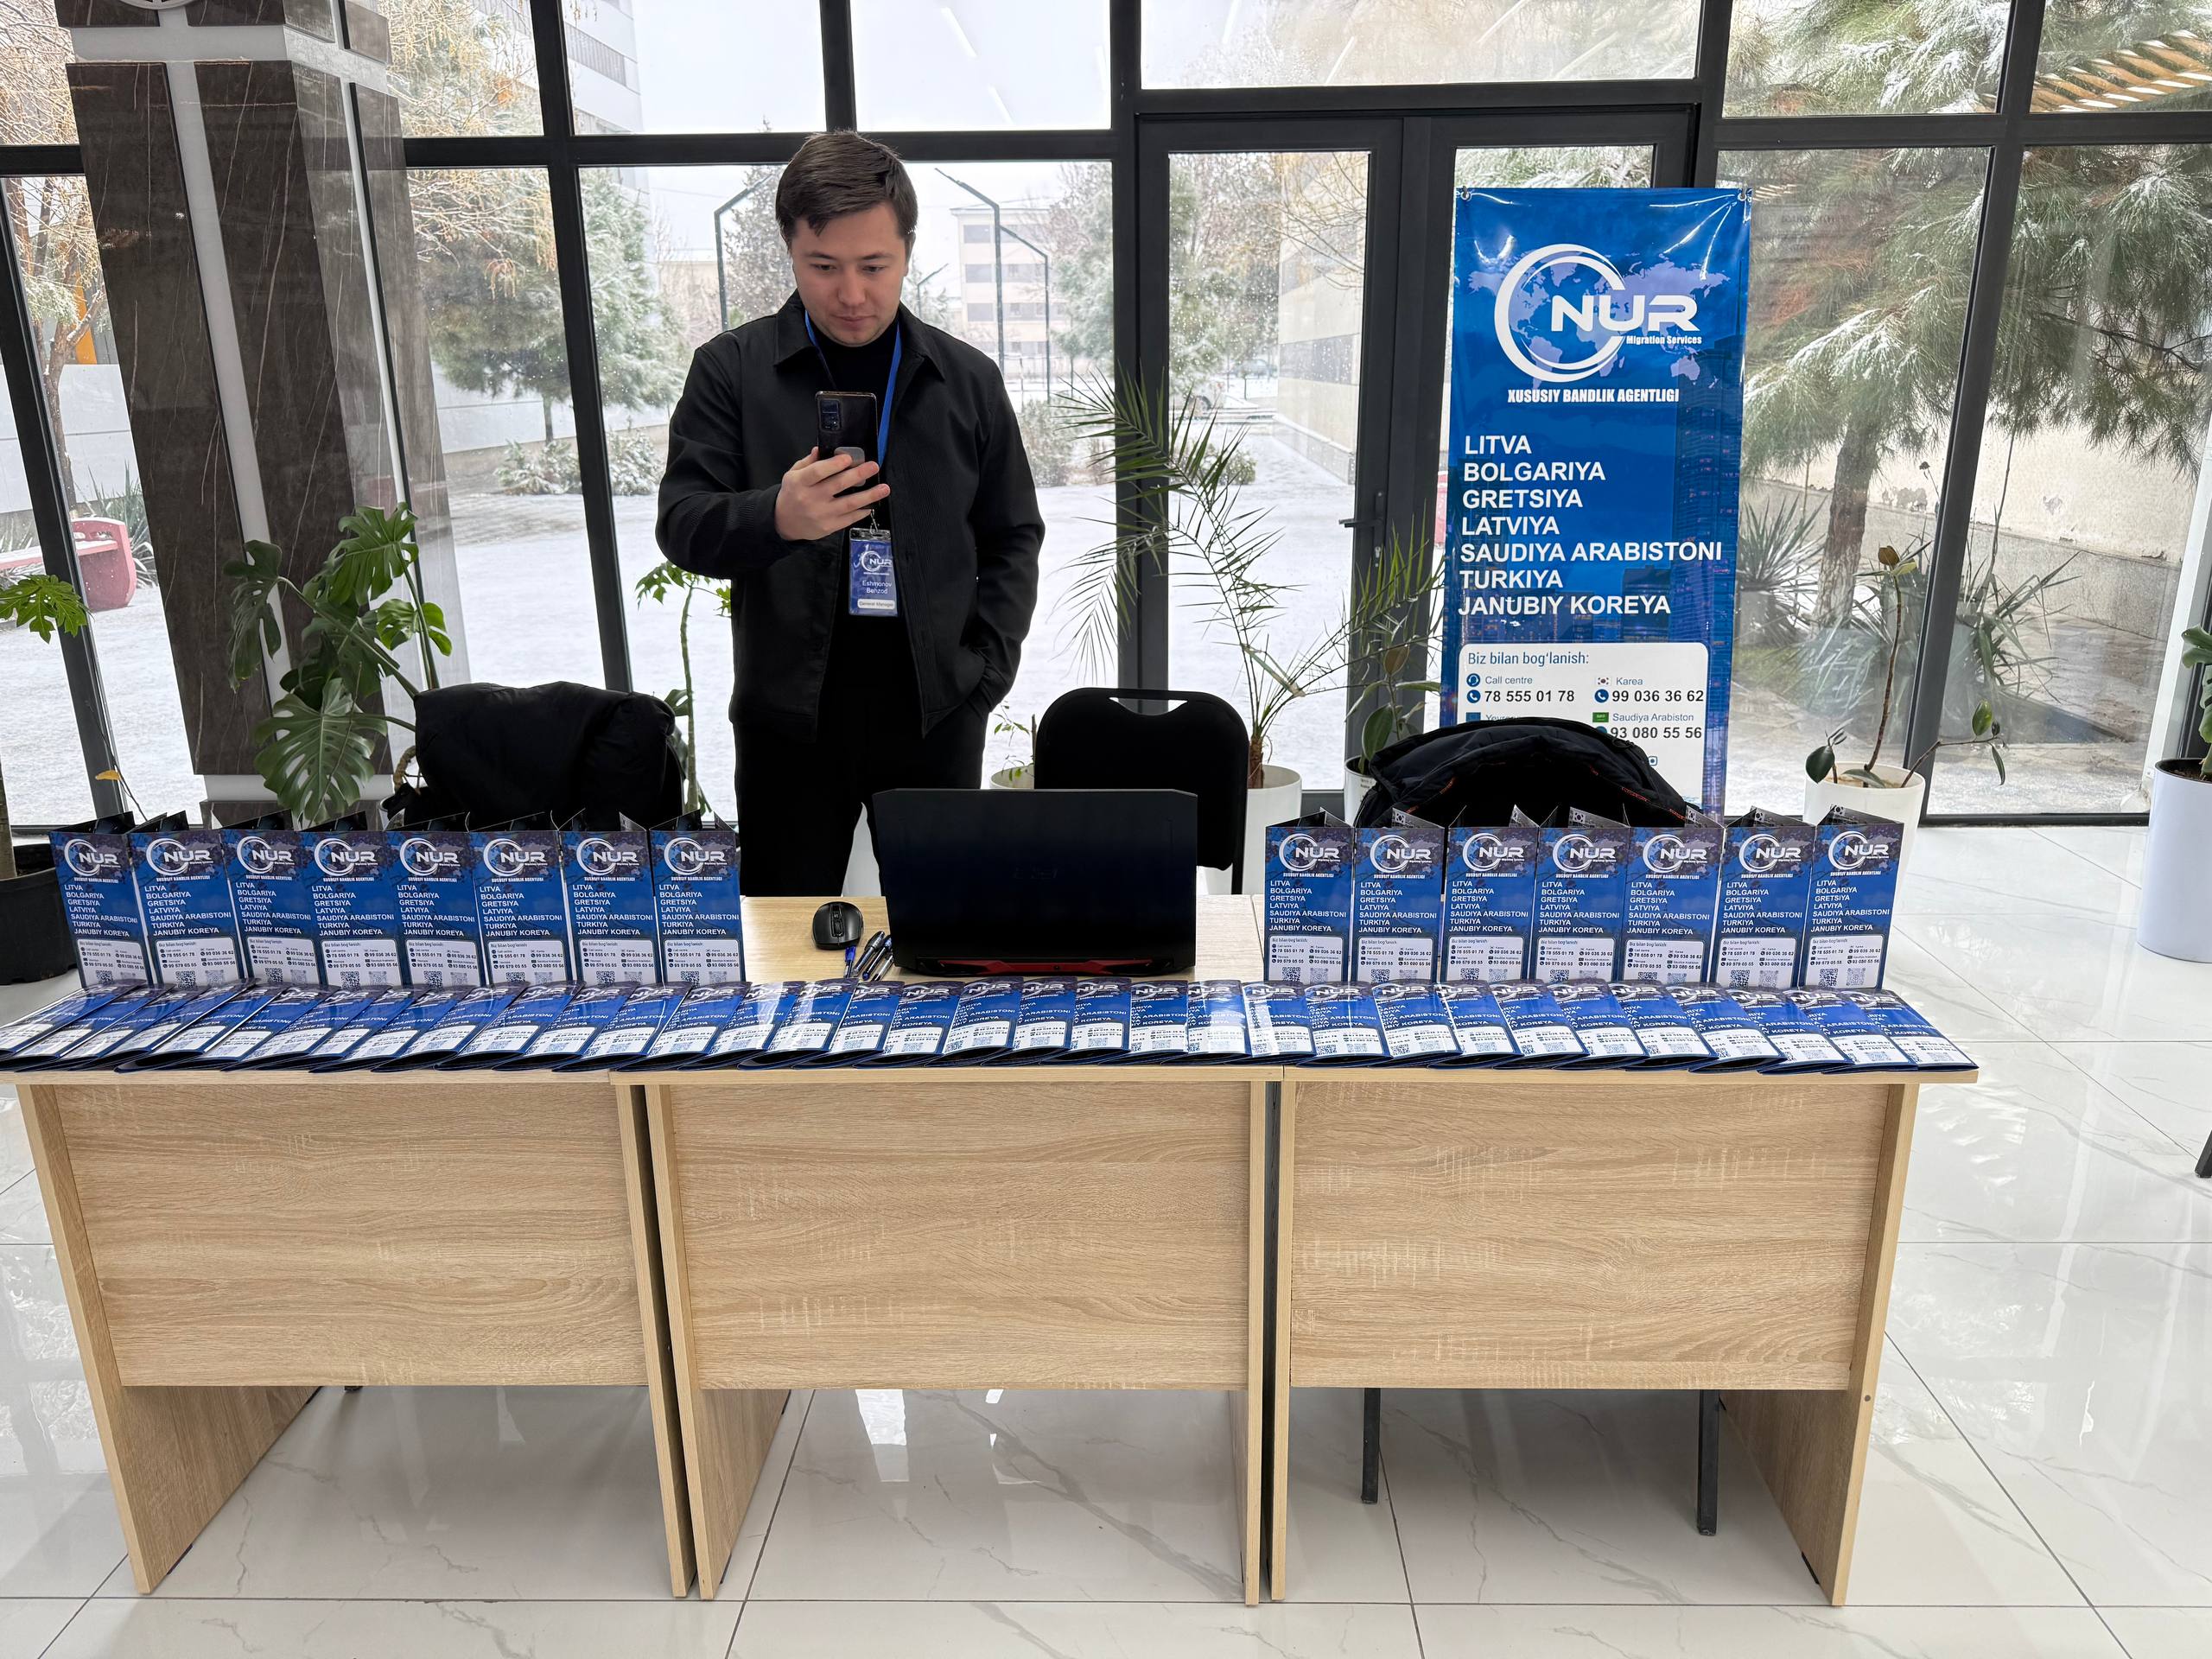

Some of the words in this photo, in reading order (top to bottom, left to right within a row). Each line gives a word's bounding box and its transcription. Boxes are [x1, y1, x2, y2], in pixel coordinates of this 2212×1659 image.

[1551, 295, 1700, 332] NUR
[1626, 335, 1665, 345] Migration
[1667, 335, 1702, 345] Services
[1507, 389, 1560, 404] XUSUSIY
[1563, 389, 1615, 403] BANDLIK
[1617, 388, 1680, 403] AGENTLIGI
[1465, 435, 1532, 454] LITVA
[1464, 461, 1606, 482] BOLGARIYA
[1462, 489, 1583, 509] GRETSIYA
[1461, 516, 1560, 536] LATVIYA
[1460, 542, 1567, 563] SAUDIYA
[1571, 541, 1722, 562] ARABISTONI
[1459, 569, 1563, 588] TURKIYA
[1458, 595, 1564, 616] JANUBIY
[1569, 594, 1671, 615] KOREYA
[1468, 652, 1486, 664] Biz
[1490, 652, 1519, 664] bilan
[1485, 676, 1503, 684] Call
[1616, 677, 1643, 685] Karea
[1484, 690, 1501, 702] 78
[1506, 690, 1531, 702] 555
[1536, 690, 1552, 702] 01
[1558, 690, 1574, 702] 78
[1612, 690, 1629, 702] 99
[1634, 690, 1659, 702] 036
[1665, 690, 1681, 702] 36
[1687, 690, 1704, 702] 62
[1612, 714, 1649, 722] Saudiya
[1611, 728, 1627, 738] 93
[1632, 728, 1658, 738] 080
[1663, 728, 1680, 738] 55
[1685, 728, 1702, 738] 56
[164, 849, 212, 862] NUR
[252, 849, 293, 861] NUR
[1294, 847, 1341, 858] NUR
[1386, 849, 1433, 859] NUR
[1478, 847, 1525, 858] NUR
[1568, 848, 1618, 859] NUR
[1659, 848, 1708, 860] NUR
[1755, 847, 1803, 859] NUR
[1843, 843, 1891, 856] NUR
[79, 852, 119, 865] NUR
[331, 851, 376, 862] NUR
[416, 851, 459, 863] NUR
[500, 851, 546, 863] NUR
[594, 851, 638, 862] NUR
[681, 851, 726, 861] NUR
[185, 912, 231, 920] ARABISTONI
